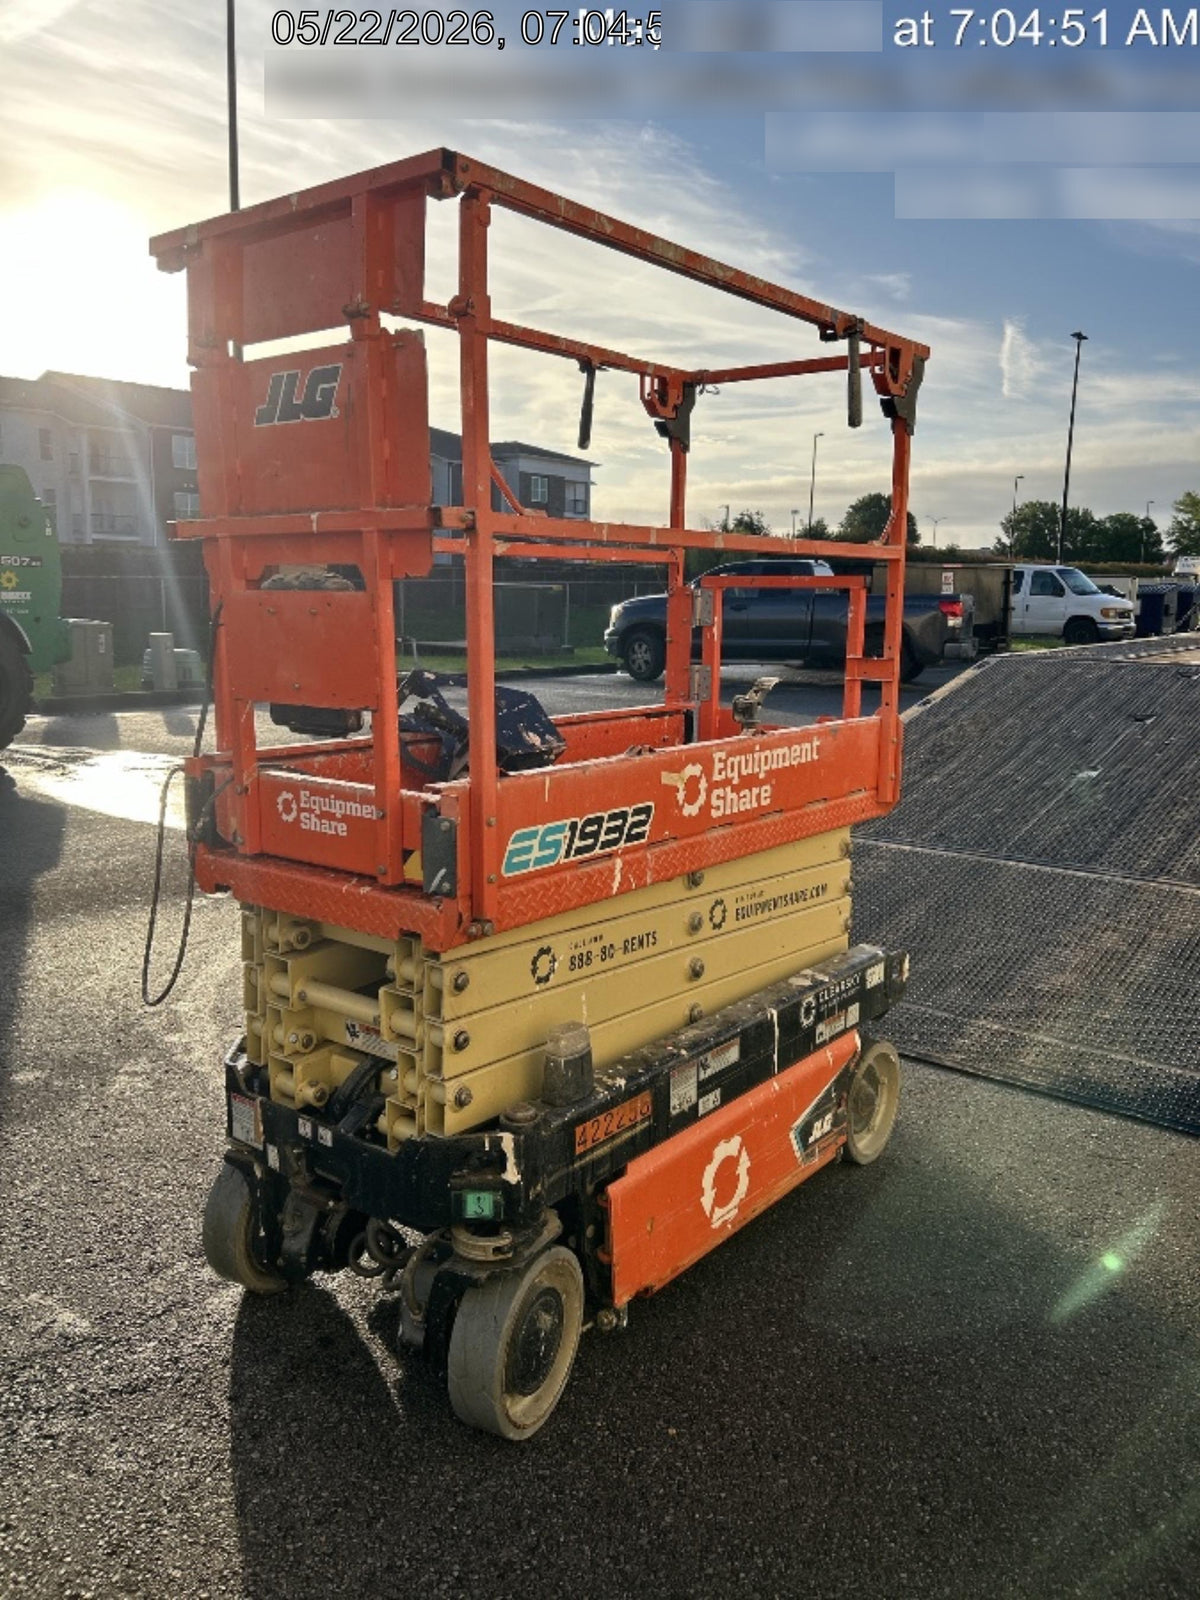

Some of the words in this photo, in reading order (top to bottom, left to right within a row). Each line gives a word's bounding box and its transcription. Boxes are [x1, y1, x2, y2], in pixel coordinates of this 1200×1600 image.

[253, 362, 344, 427] JLG
[711, 736, 821, 785] Equipment
[300, 811, 348, 837] Share
[710, 784, 773, 818] Share
[501, 801, 655, 877] ES1932
